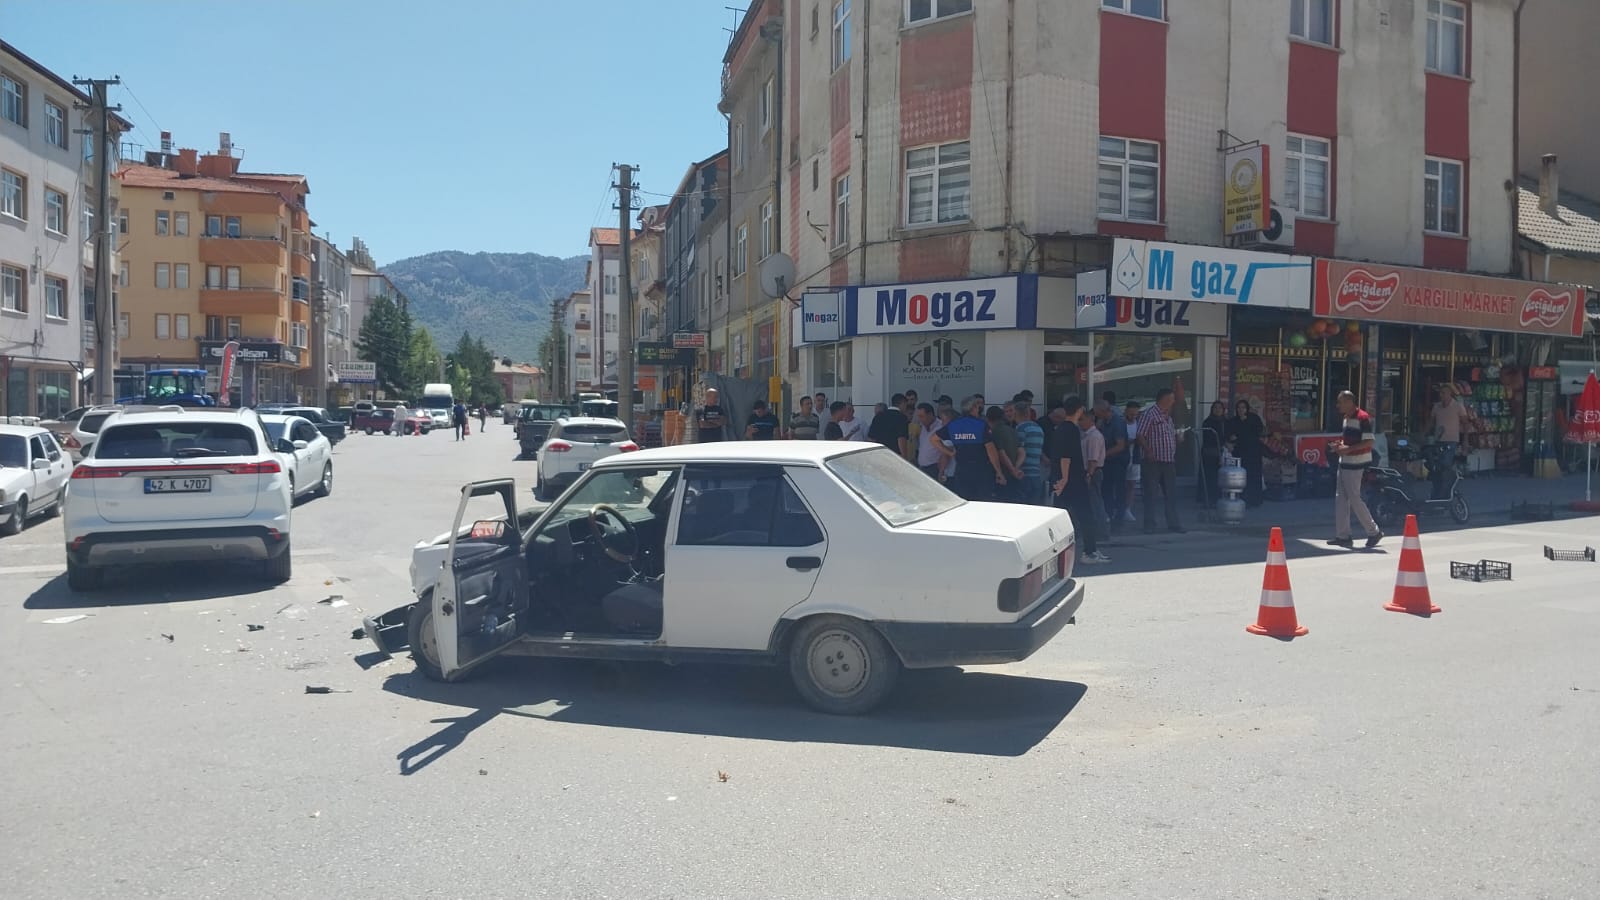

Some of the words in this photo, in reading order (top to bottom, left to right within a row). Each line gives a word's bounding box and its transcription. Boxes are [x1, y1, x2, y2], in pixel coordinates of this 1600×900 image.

[1191, 259, 1238, 298] gaz
[876, 288, 996, 327] Mogaz
[1077, 293, 1106, 306] Mogaz
[1117, 296, 1190, 328] ogaz
[1403, 286, 1458, 309] KARGILI
[1462, 292, 1516, 313] MARKET
[804, 312, 838, 324] Mogaz
[151, 480, 163, 490] 42
[170, 480, 176, 489] K
[184, 479, 207, 489] 4707
